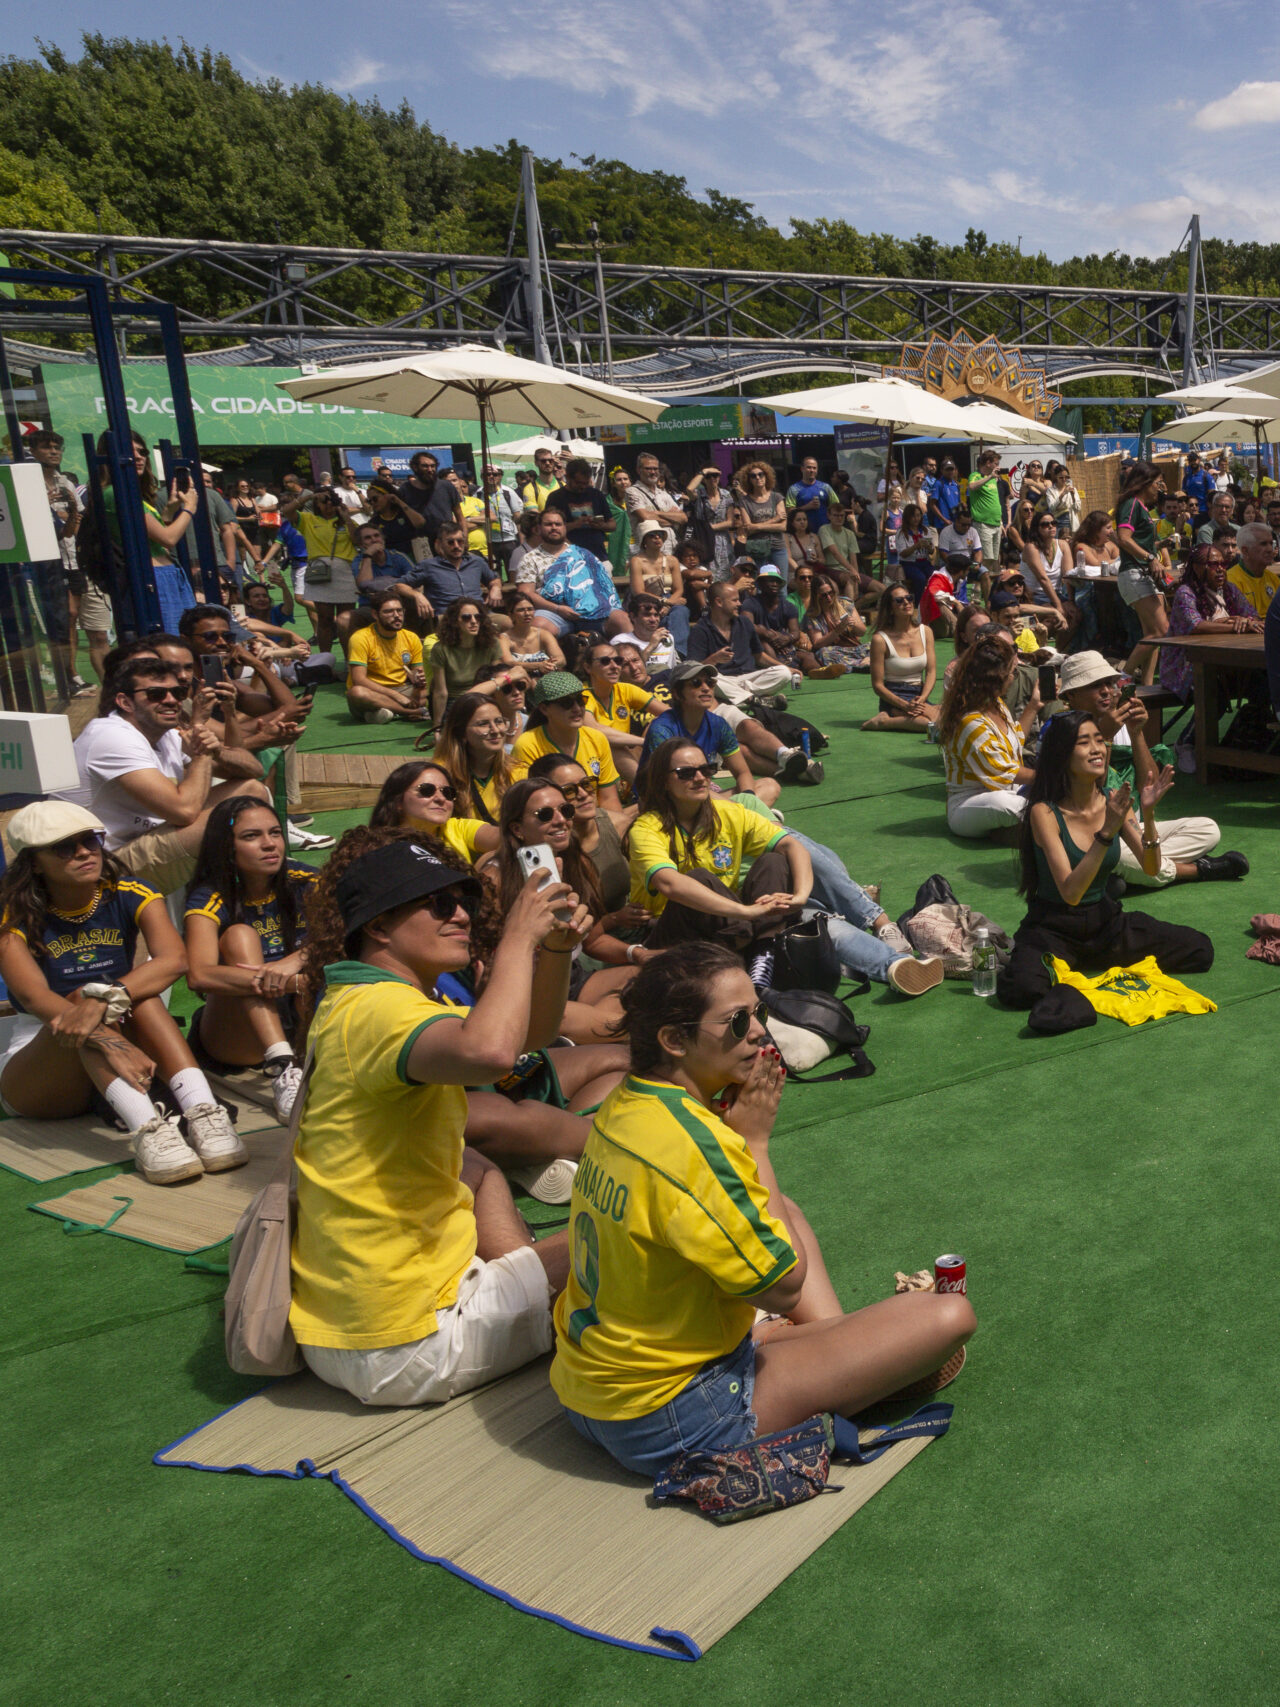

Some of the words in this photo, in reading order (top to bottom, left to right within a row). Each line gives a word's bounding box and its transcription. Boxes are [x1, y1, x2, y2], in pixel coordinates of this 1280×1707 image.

[211, 397, 315, 414] CIDADE
[652, 419, 682, 431] ESTAÇÃO
[683, 418, 714, 429] ESPORTE
[46, 928, 123, 958] BRASIL
